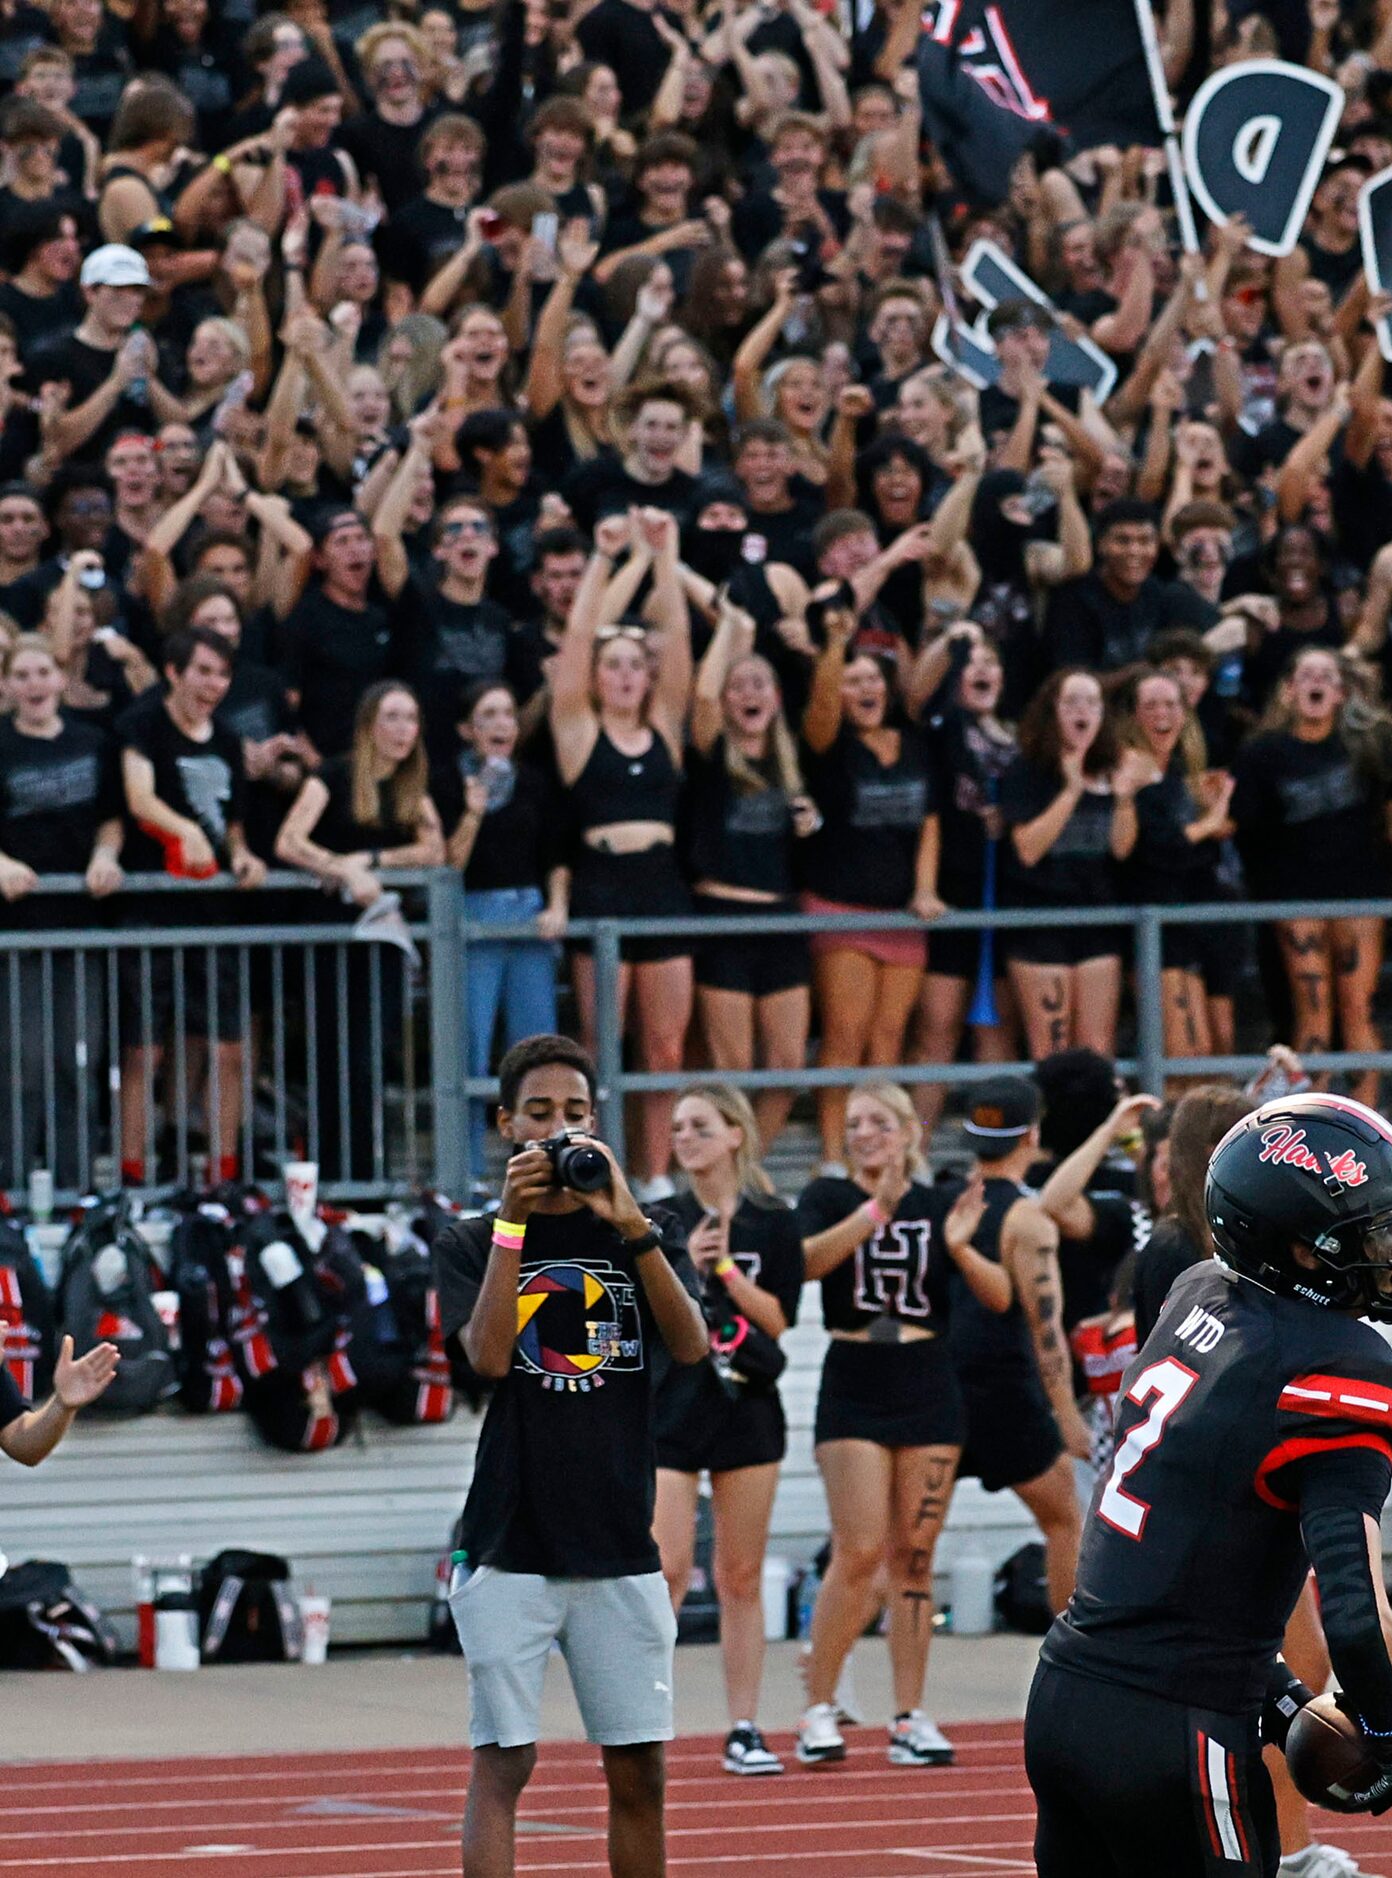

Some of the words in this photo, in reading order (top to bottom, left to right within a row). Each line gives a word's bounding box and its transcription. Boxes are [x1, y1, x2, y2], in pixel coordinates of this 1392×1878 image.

[854, 1219, 931, 1317] H
[1293, 1282, 1331, 1306] schutt
[1174, 1305, 1226, 1354] WTD
[1095, 1354, 1201, 1543] 2
